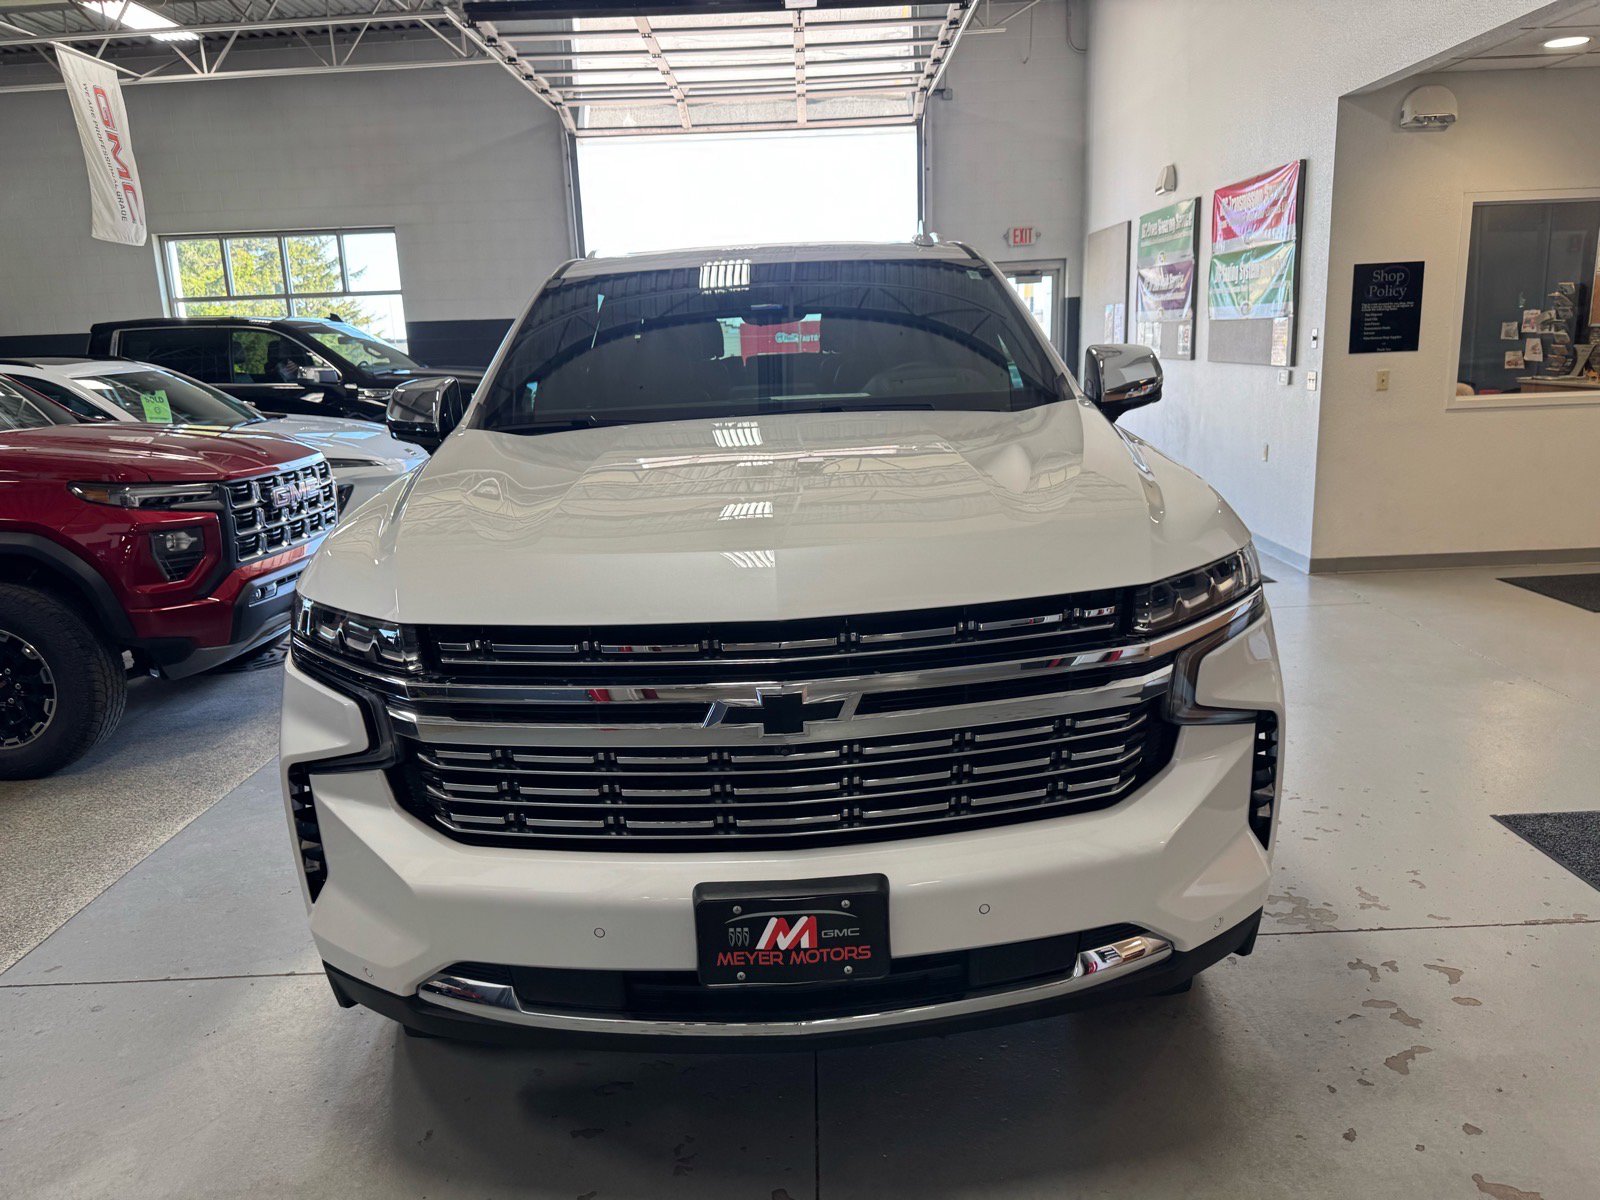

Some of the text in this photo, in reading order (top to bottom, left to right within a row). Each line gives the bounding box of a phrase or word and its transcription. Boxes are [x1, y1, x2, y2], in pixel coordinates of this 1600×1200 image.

[82, 83, 128, 222] WE ARE PROFESSIONAL GRADE
[93, 84, 144, 226] GMC
[1013, 227, 1033, 244] EXIT
[1372, 269, 1405, 285] Shop
[1369, 285, 1407, 300] Policy
[271, 476, 320, 508] GMC
[821, 927, 860, 938] GMC
[717, 945, 872, 967] MEYER MOTORS
